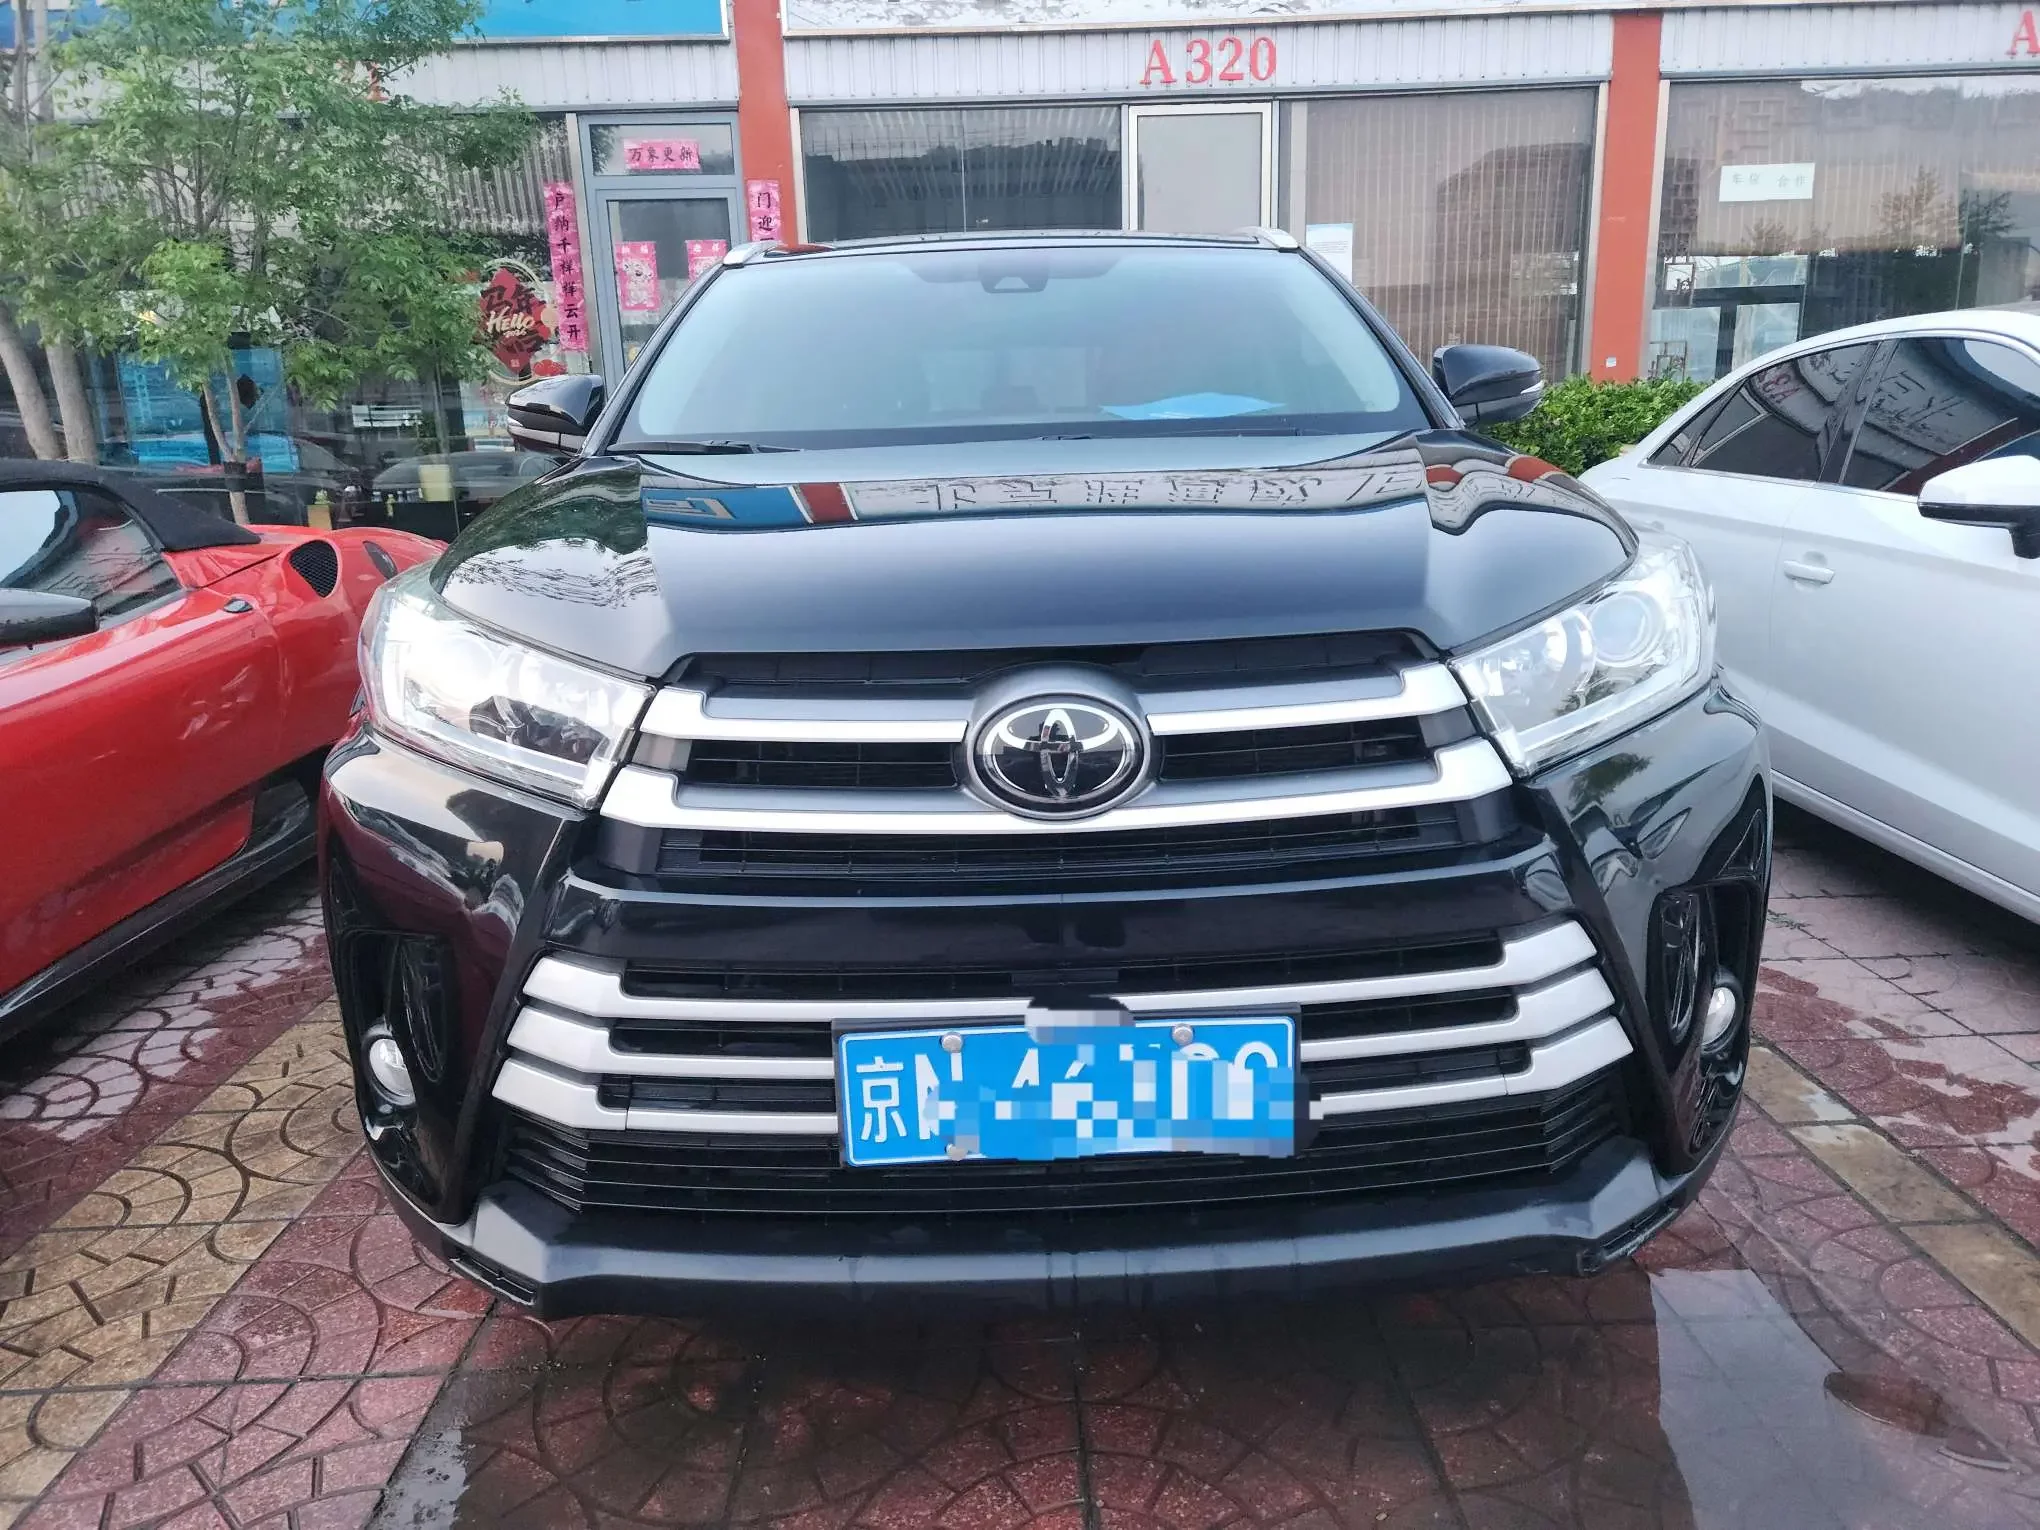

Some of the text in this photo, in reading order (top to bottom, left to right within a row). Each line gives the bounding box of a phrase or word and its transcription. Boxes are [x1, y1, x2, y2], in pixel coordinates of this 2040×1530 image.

[1139, 35, 1277, 85] A320
[629, 146, 694, 162] 万象更新
[757, 192, 775, 241] 门迎
